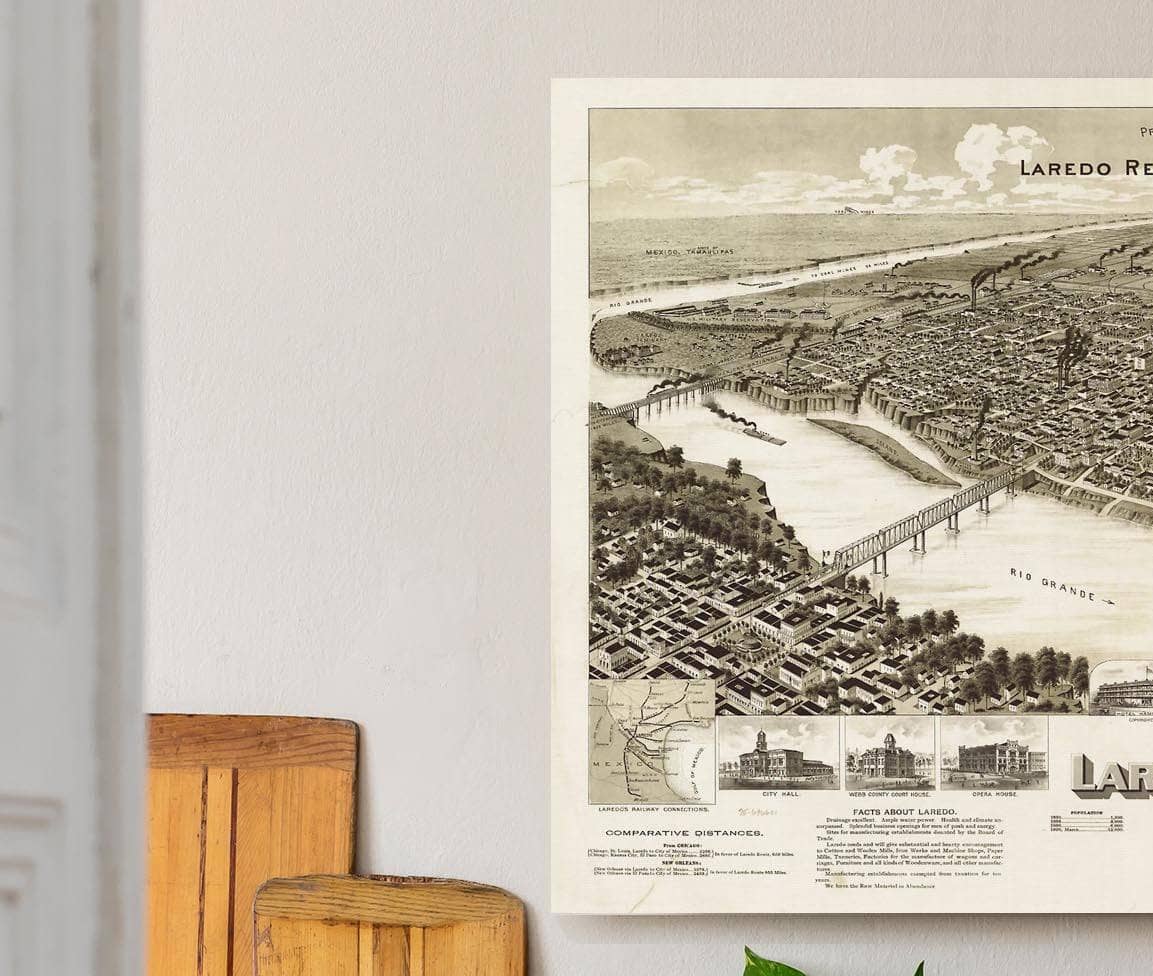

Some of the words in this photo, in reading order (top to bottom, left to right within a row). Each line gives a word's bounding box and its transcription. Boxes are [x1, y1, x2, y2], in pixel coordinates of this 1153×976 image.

[1021, 160, 1112, 176] LAREDO
[1010, 568, 1032, 580] RIO
[1042, 578, 1095, 601] GRANDE
